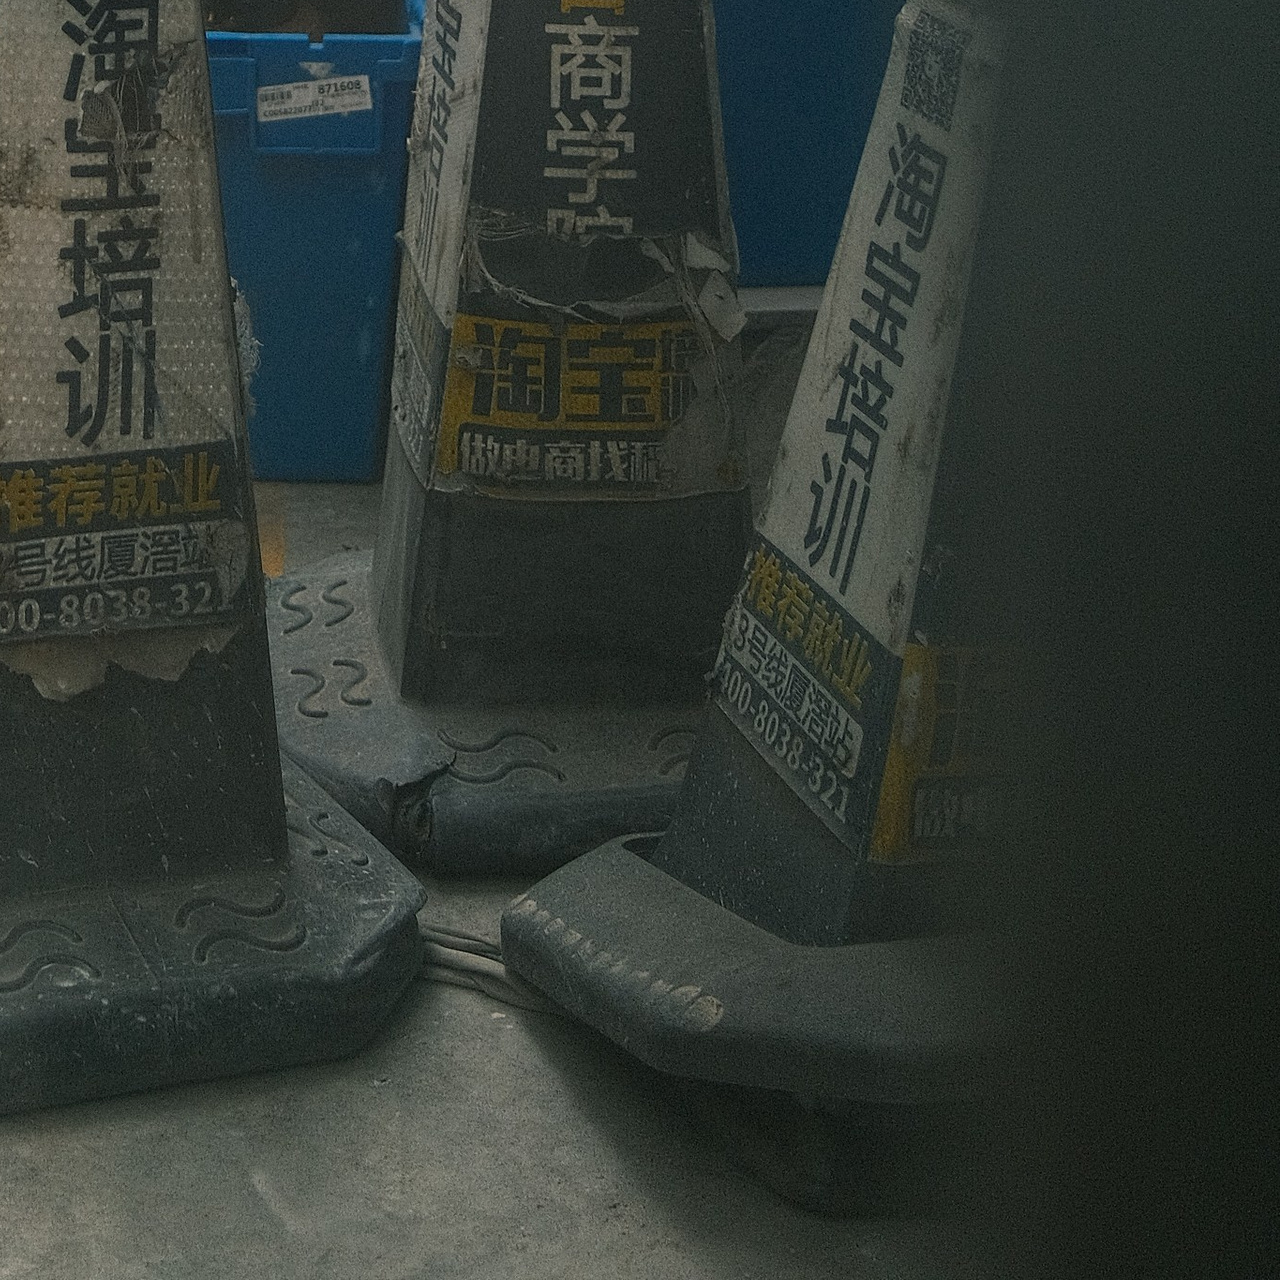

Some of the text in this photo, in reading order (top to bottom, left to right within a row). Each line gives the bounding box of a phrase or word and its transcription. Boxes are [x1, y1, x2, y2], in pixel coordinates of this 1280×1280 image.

[471, 321, 655, 423] 淘宝
[803, 122, 949, 597] 淘宝培训
[745, 543, 872, 710] 推荐就业
